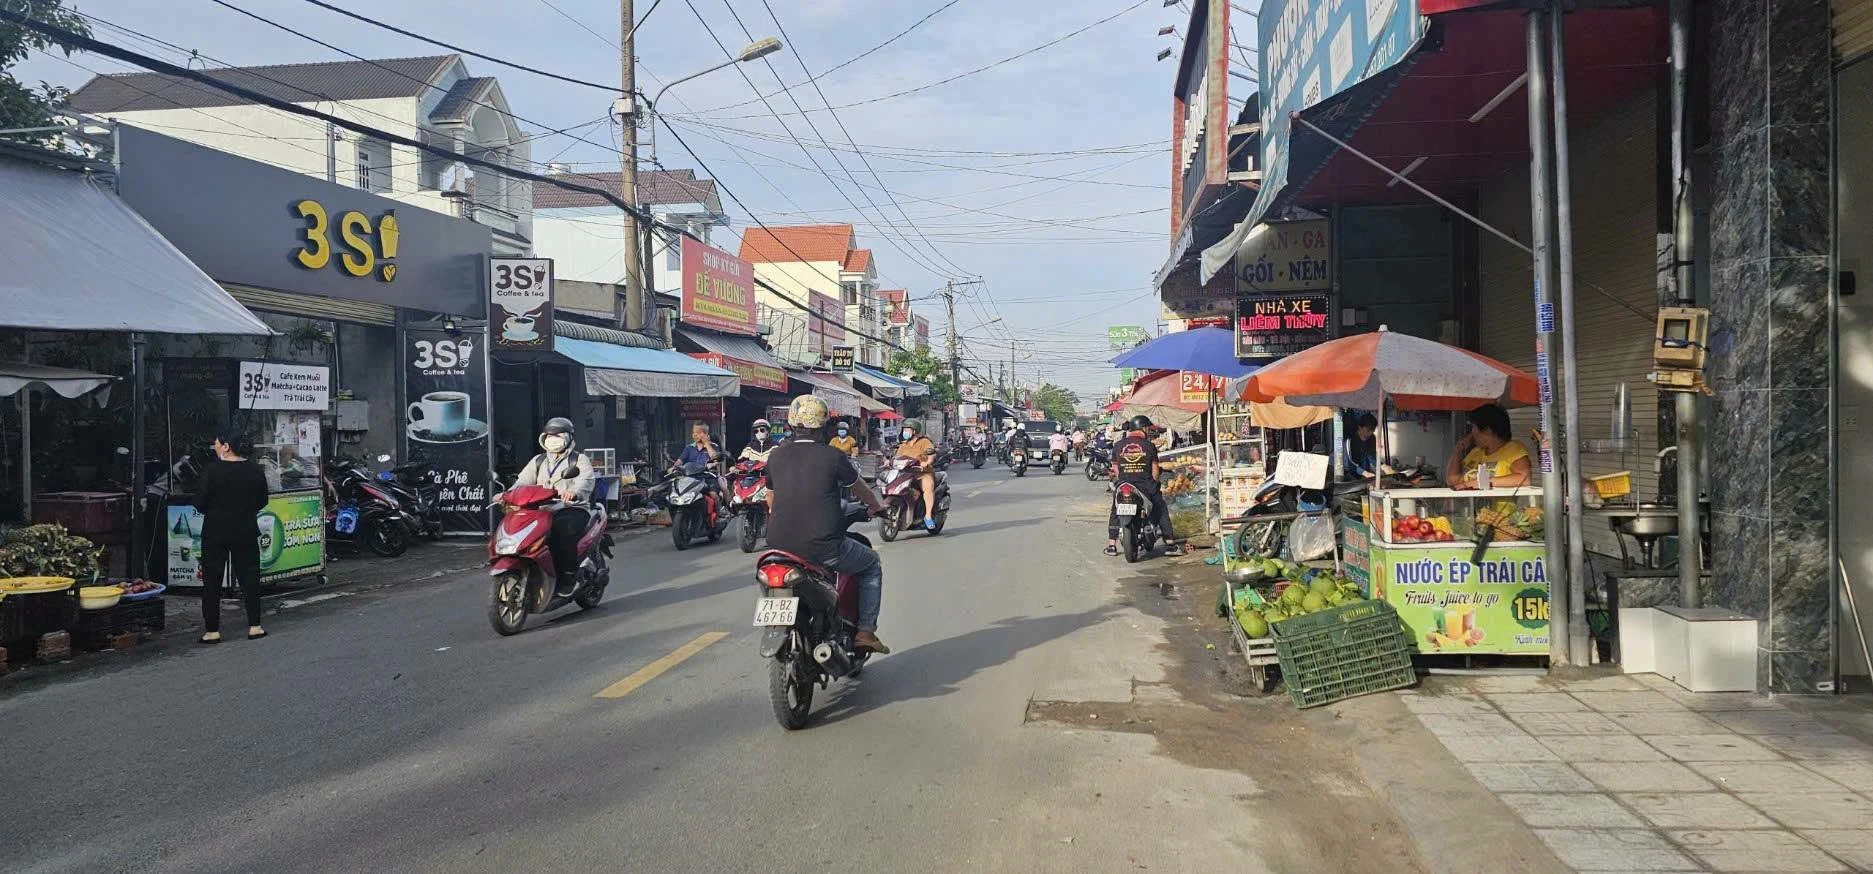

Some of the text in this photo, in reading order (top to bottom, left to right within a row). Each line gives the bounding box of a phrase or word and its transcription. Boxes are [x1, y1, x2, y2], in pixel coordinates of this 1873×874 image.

[703, 252, 719, 268] SHOP
[1243, 253, 1327, 286] GỐI NỆM
[1291, 300, 1312, 313] XE
[445, 469, 468, 484] Phê
[459, 485, 484, 500] Chất
[1396, 558, 1443, 584] NƯỚC
[1449, 558, 1471, 584] ÉP
[1478, 557, 1516, 583] TRÁI
[1521, 556, 1547, 584] CÂ
[1405, 590, 1500, 607] Fruits Juice to go
